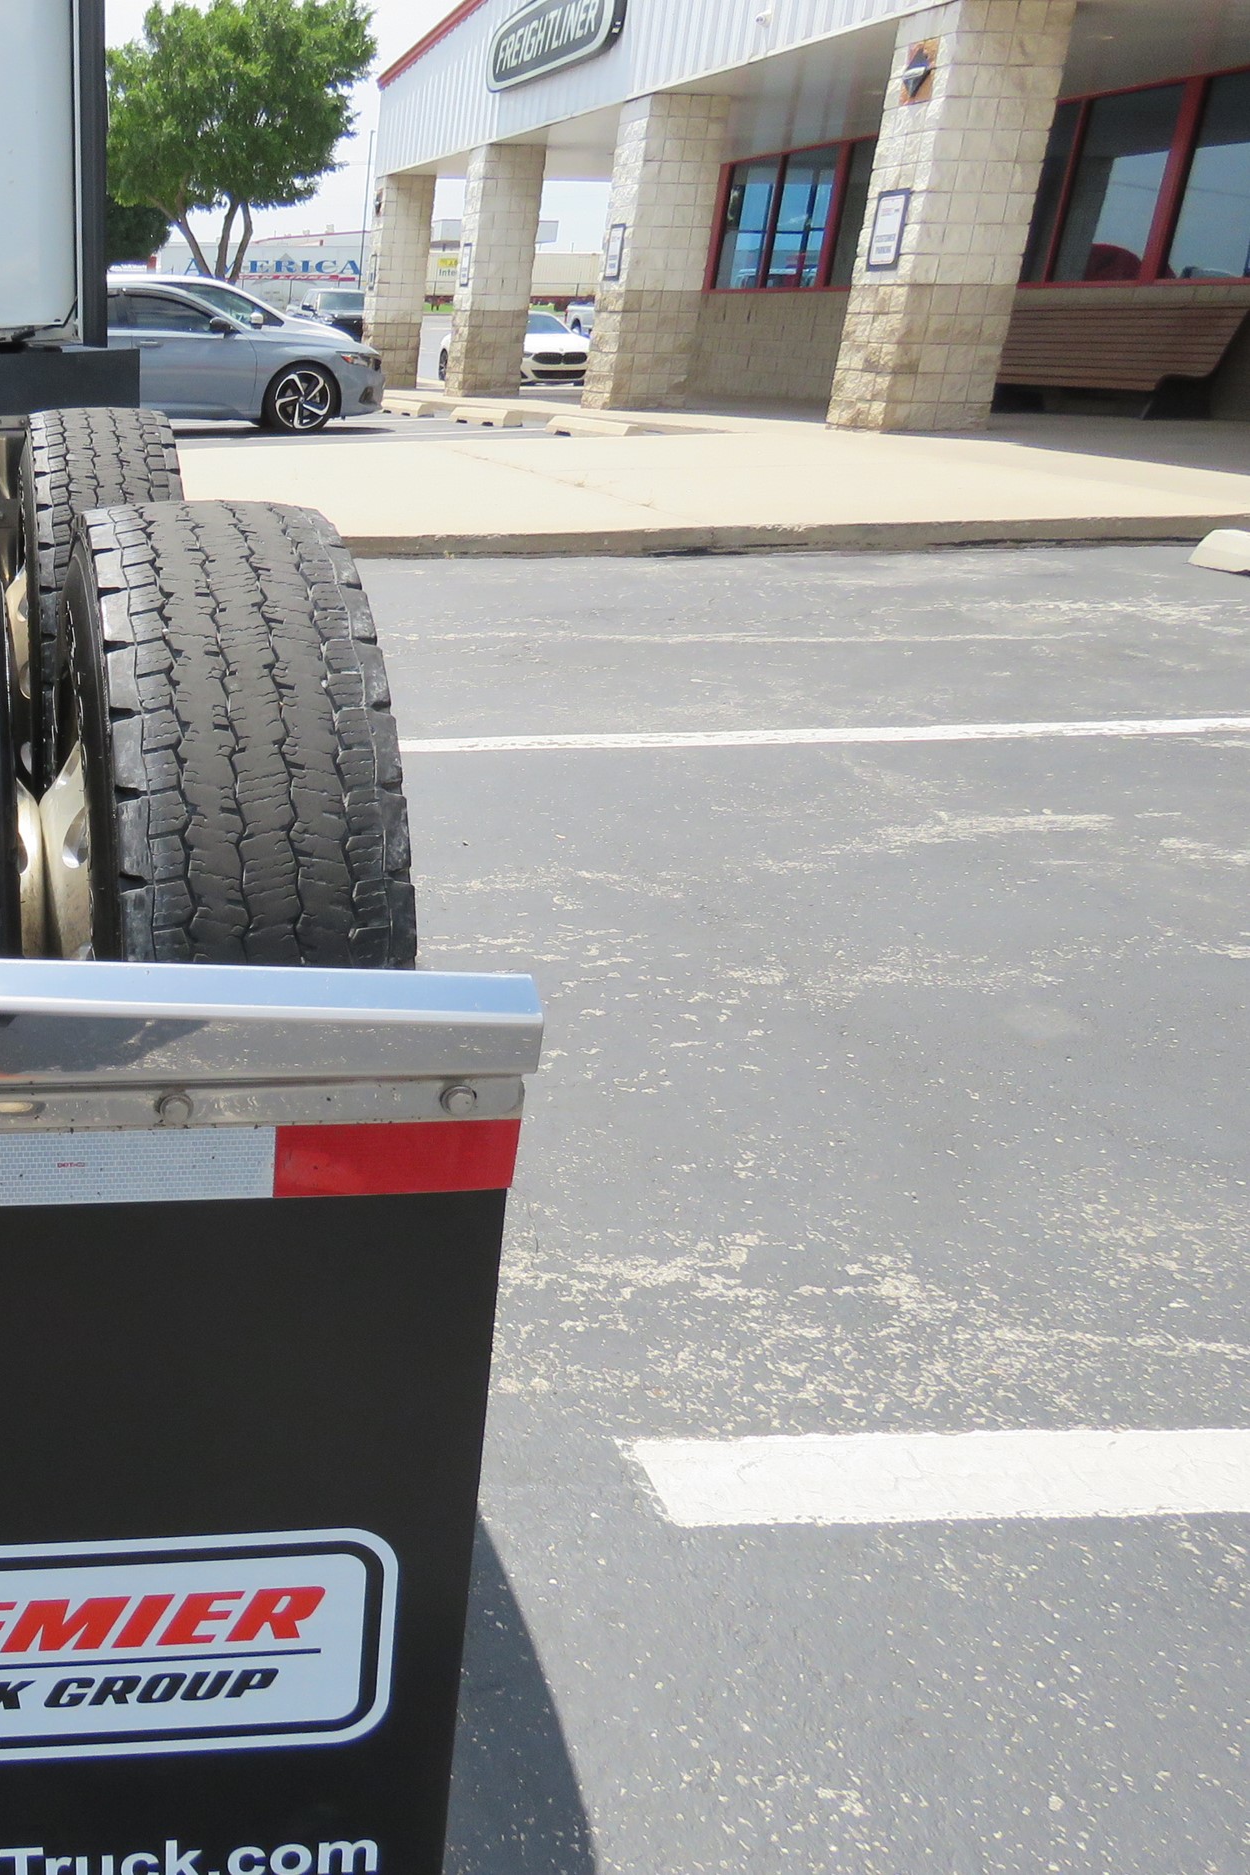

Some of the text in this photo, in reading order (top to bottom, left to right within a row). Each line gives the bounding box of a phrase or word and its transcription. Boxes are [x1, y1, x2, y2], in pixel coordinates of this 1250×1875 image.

[495, 0, 599, 74] FREIGHTLINER
[183, 258, 363, 275] AERICA
[43, 1668, 279, 1708] GROUP
